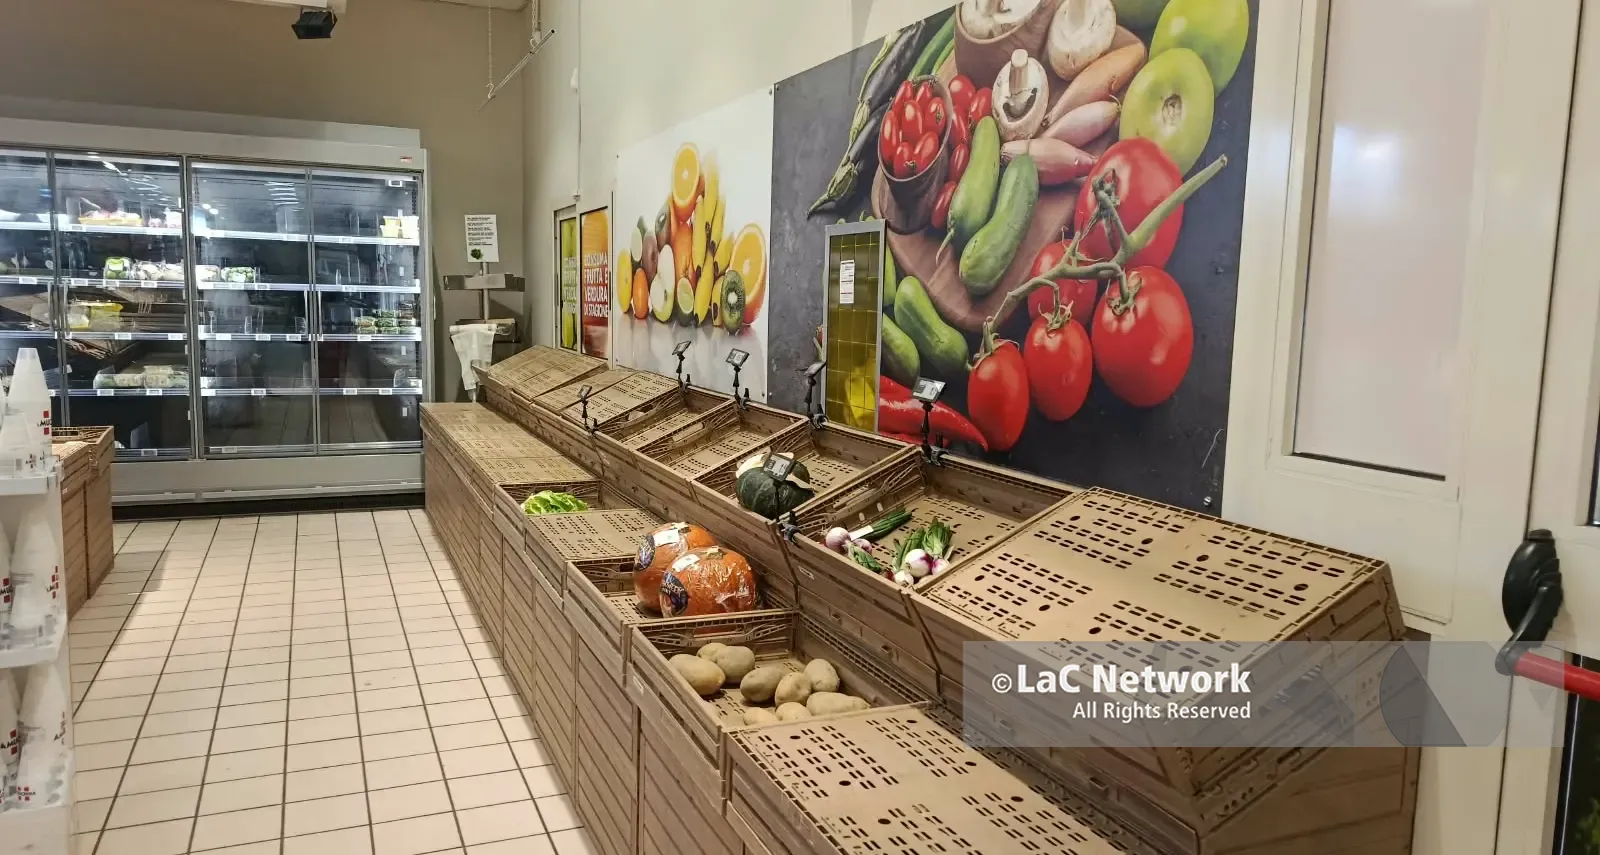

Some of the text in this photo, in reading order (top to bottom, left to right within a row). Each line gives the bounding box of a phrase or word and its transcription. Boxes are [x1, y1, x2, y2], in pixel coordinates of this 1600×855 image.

[584, 252, 608, 266] CONSUMA
[584, 267, 603, 284] FRUTTA
[584, 286, 608, 302] VERDURA
